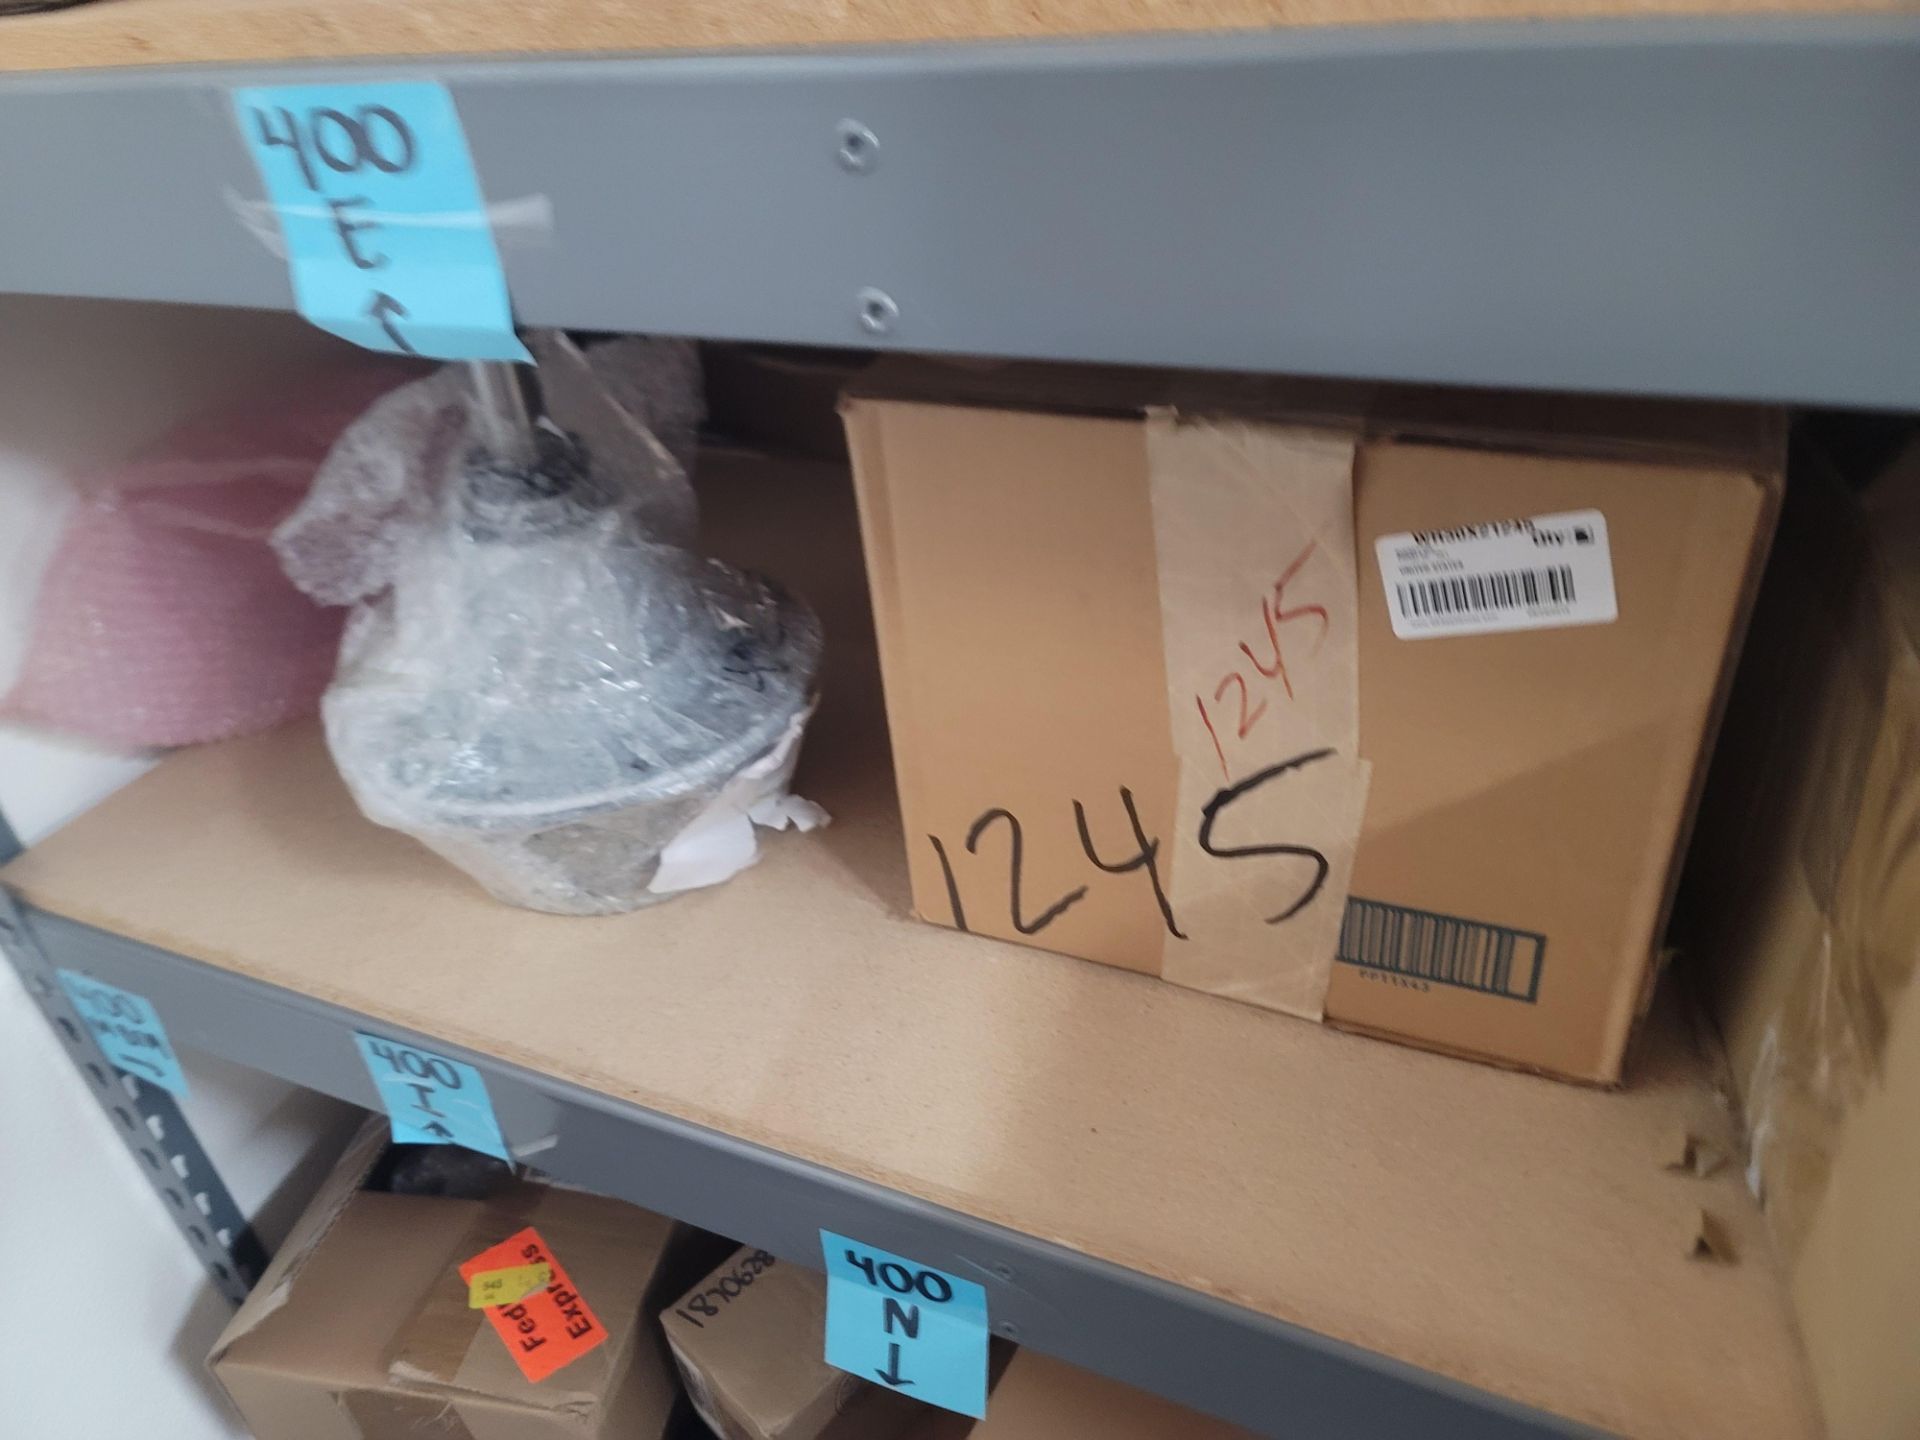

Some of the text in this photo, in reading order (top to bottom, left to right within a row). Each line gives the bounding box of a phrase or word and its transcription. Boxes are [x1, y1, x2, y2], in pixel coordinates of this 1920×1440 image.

[250, 104, 414, 191] 400
[323, 195, 388, 270] E
[1196, 539, 1329, 781] 1245
[927, 746, 1337, 941] 1245
[367, 1040, 463, 1090] 400
[844, 1248, 954, 1303] 400
[882, 1297, 920, 1340] N
